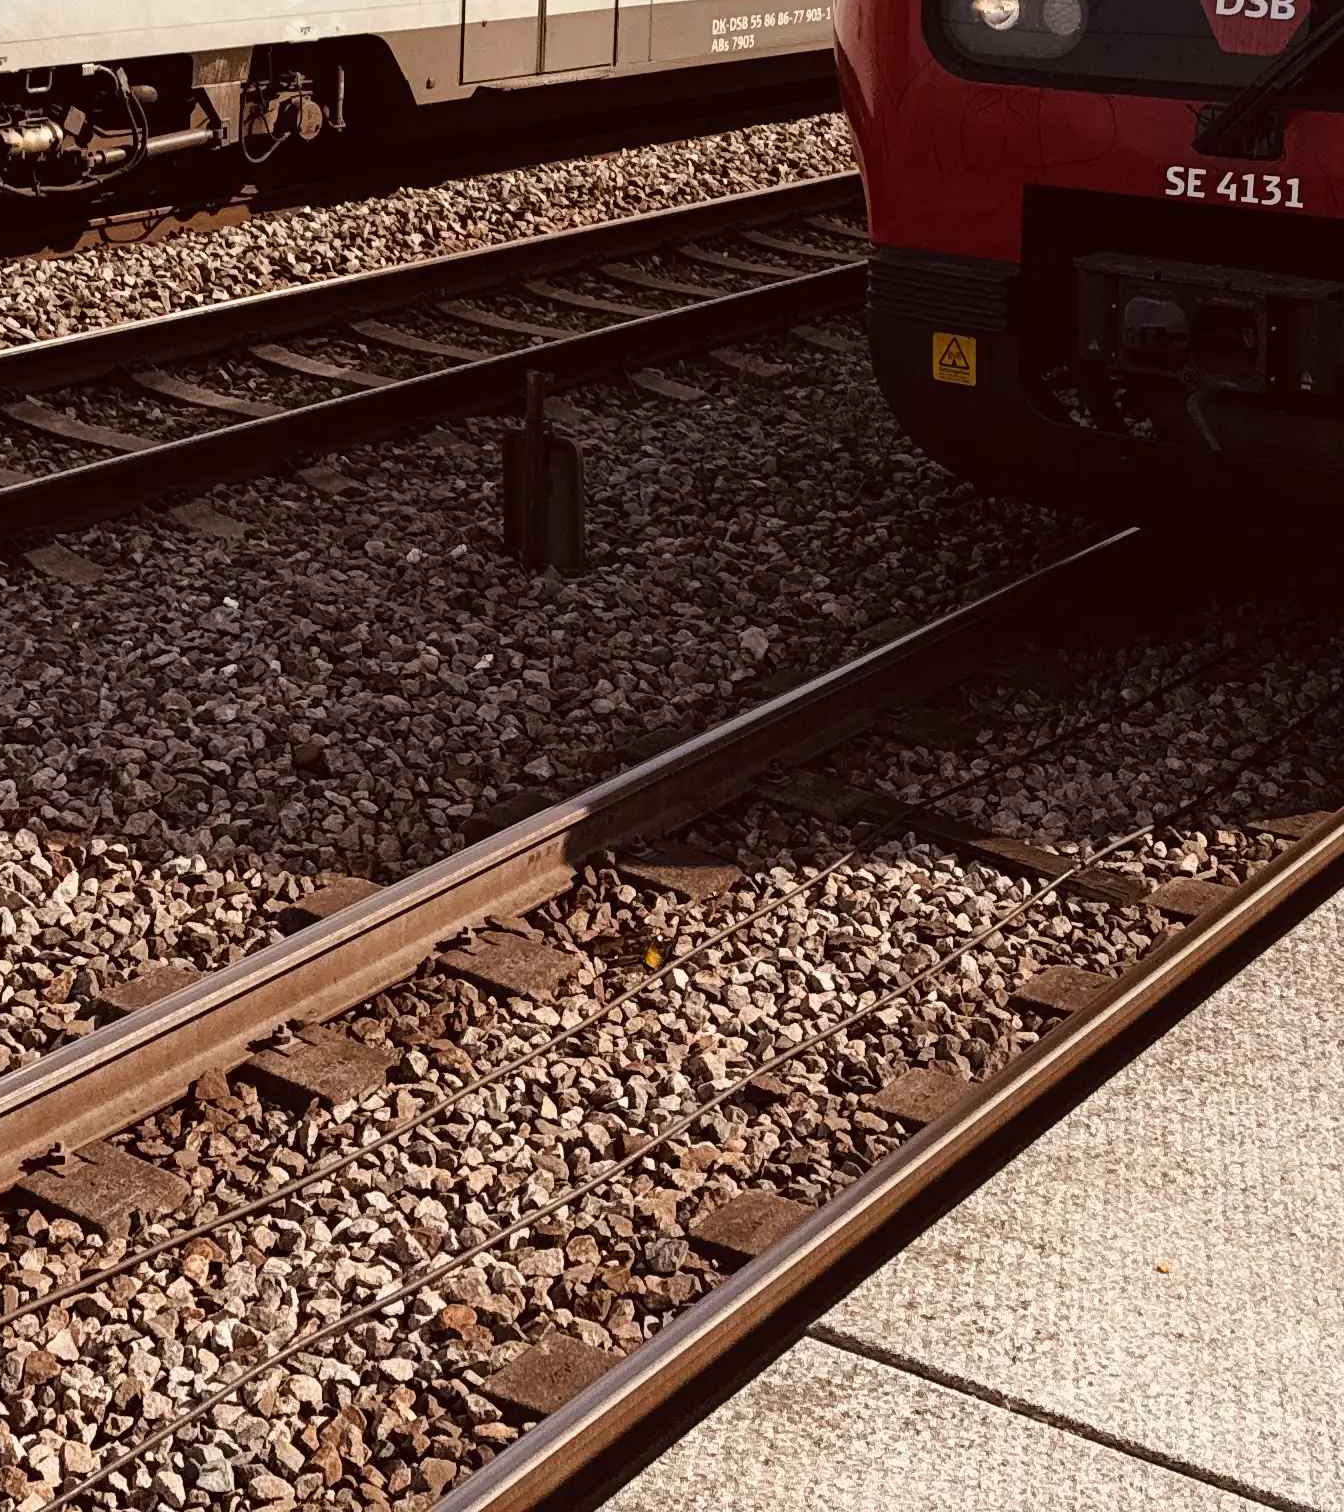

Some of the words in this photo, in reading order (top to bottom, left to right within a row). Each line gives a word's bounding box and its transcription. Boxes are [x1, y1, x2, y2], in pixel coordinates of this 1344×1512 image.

[750, 14, 762, 30] 55
[764, 12, 776, 28] 86
[777, 9, 805, 26] 86-77
[805, 6, 832, 23] 903-1
[711, 38, 730, 53] ABs
[732, 34, 755, 51] 7903
[1164, 165, 1207, 199] SE
[1216, 170, 1304, 209] 4131
